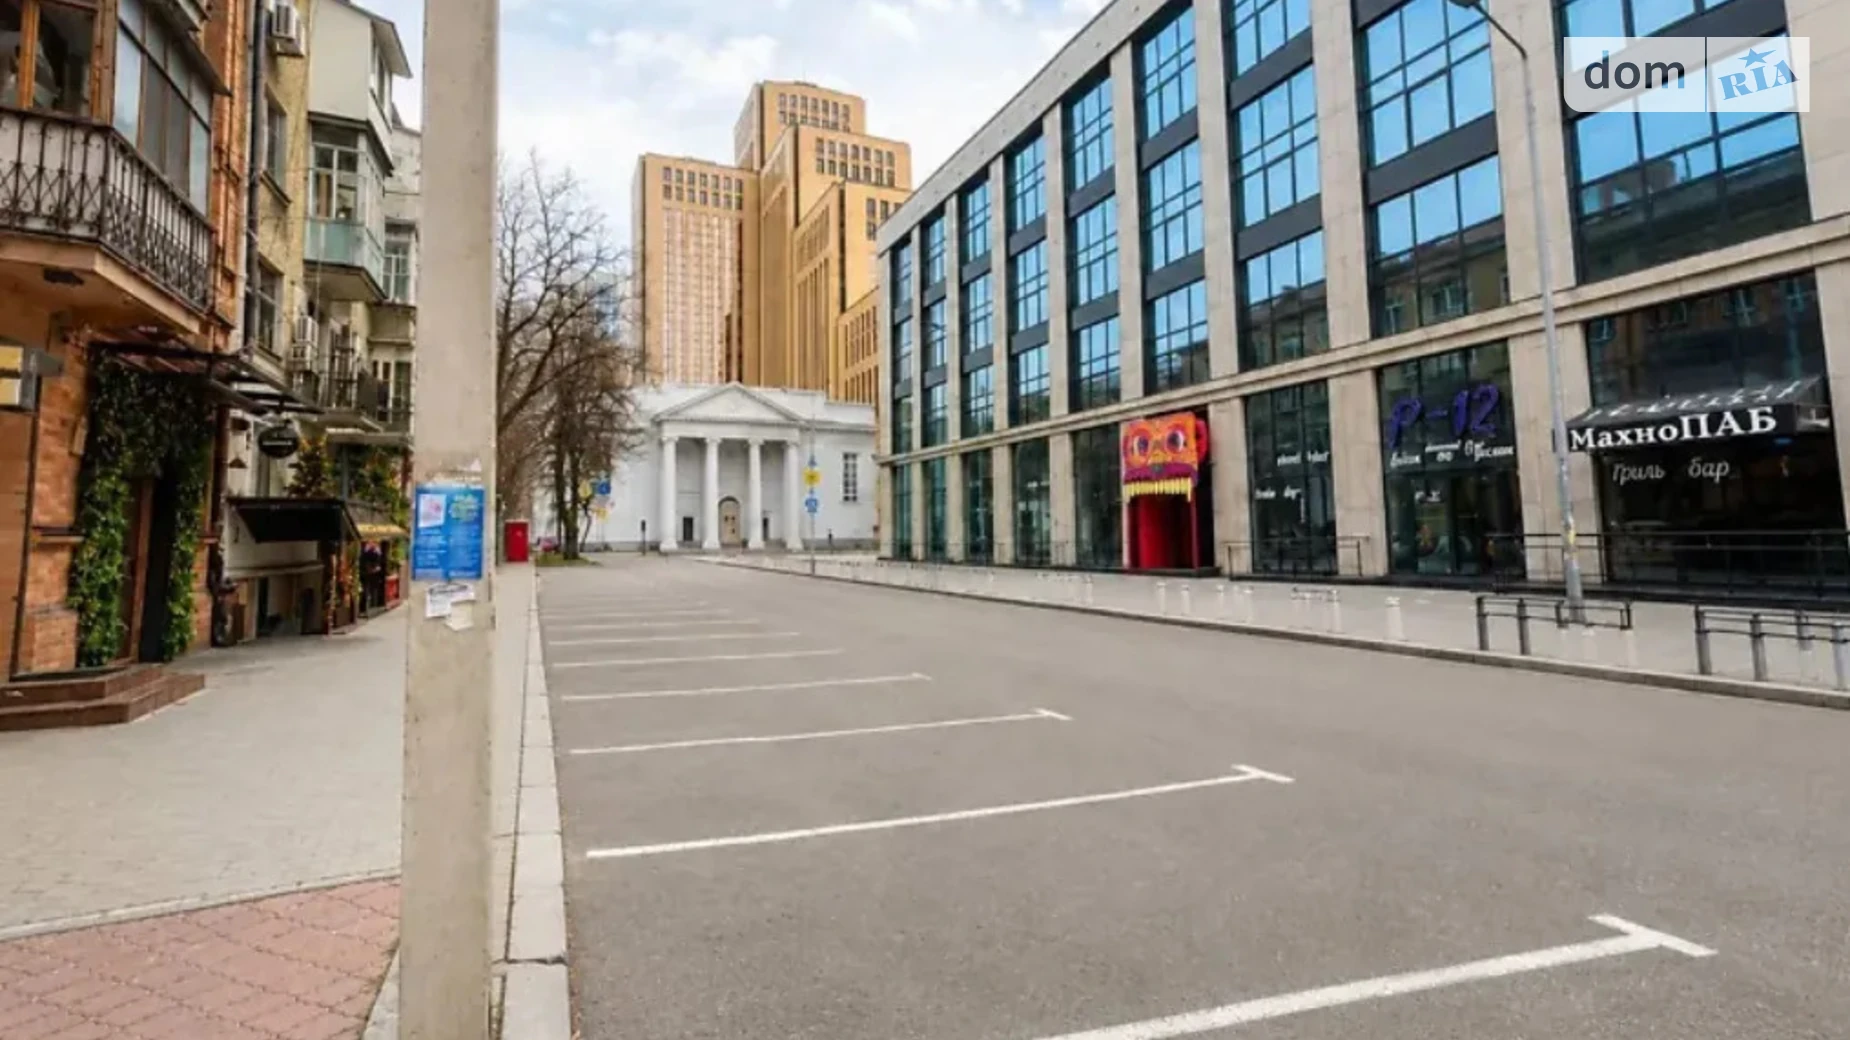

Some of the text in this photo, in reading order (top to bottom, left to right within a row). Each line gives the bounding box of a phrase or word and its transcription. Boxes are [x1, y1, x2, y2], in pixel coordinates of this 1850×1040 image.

[1569, 406, 1778, 451] МахноПАБ
[1612, 456, 1730, 486] Гриль бар
